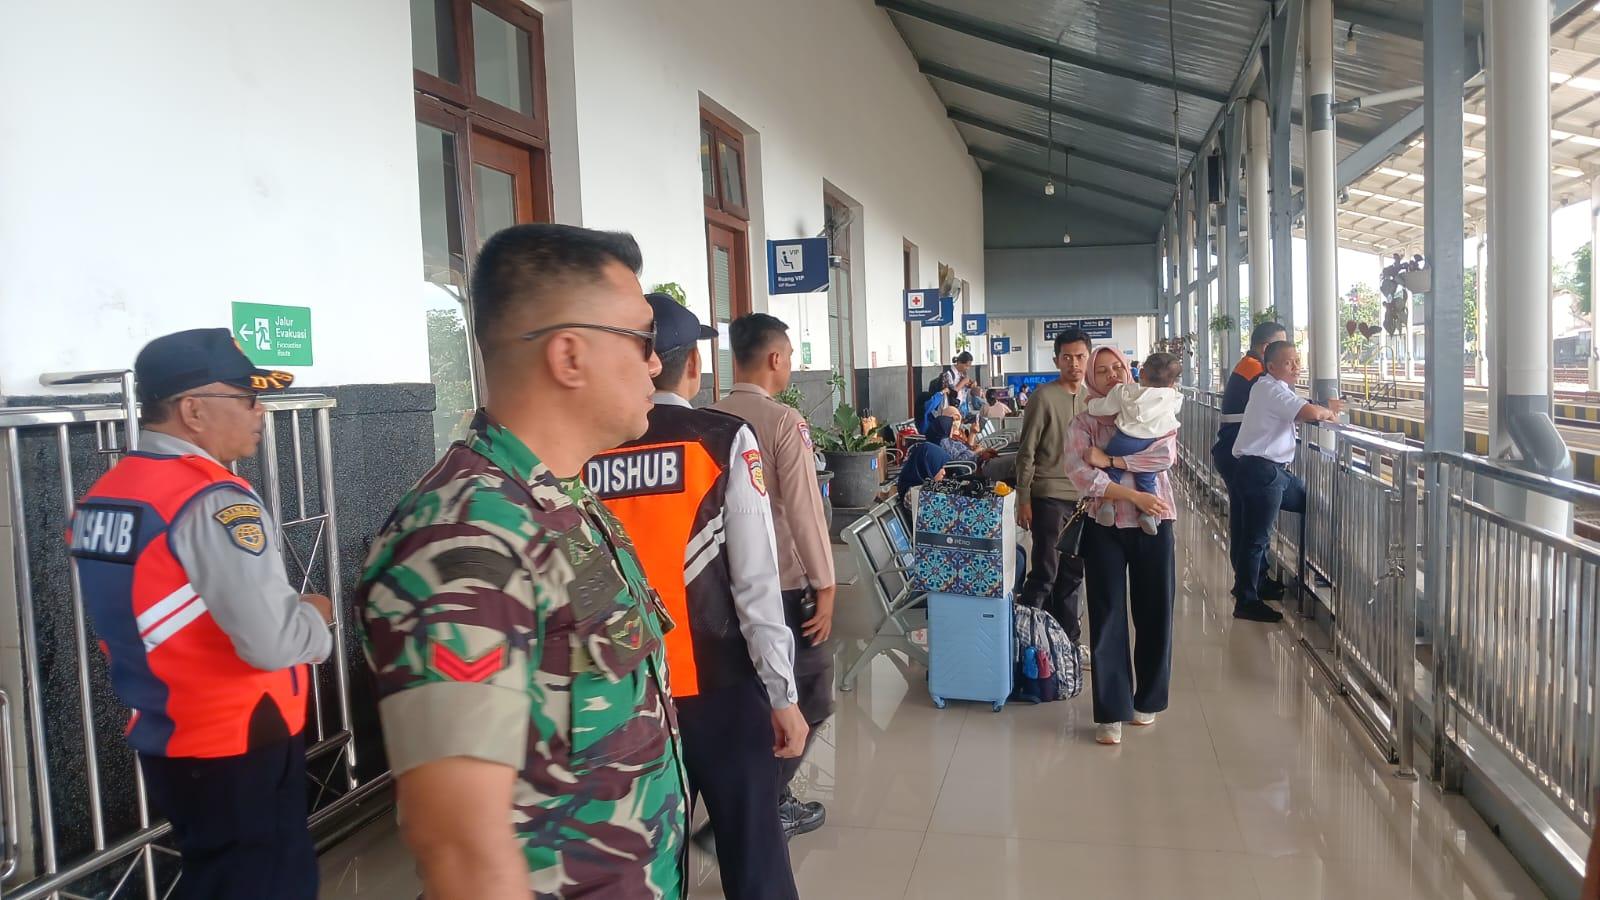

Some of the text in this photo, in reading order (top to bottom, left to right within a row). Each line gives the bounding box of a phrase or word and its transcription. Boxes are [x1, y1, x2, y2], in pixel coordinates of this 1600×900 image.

[275, 315, 294, 327] Jalur
[275, 327, 307, 339] Evakuasi
[588, 451, 678, 494] DISHUB
